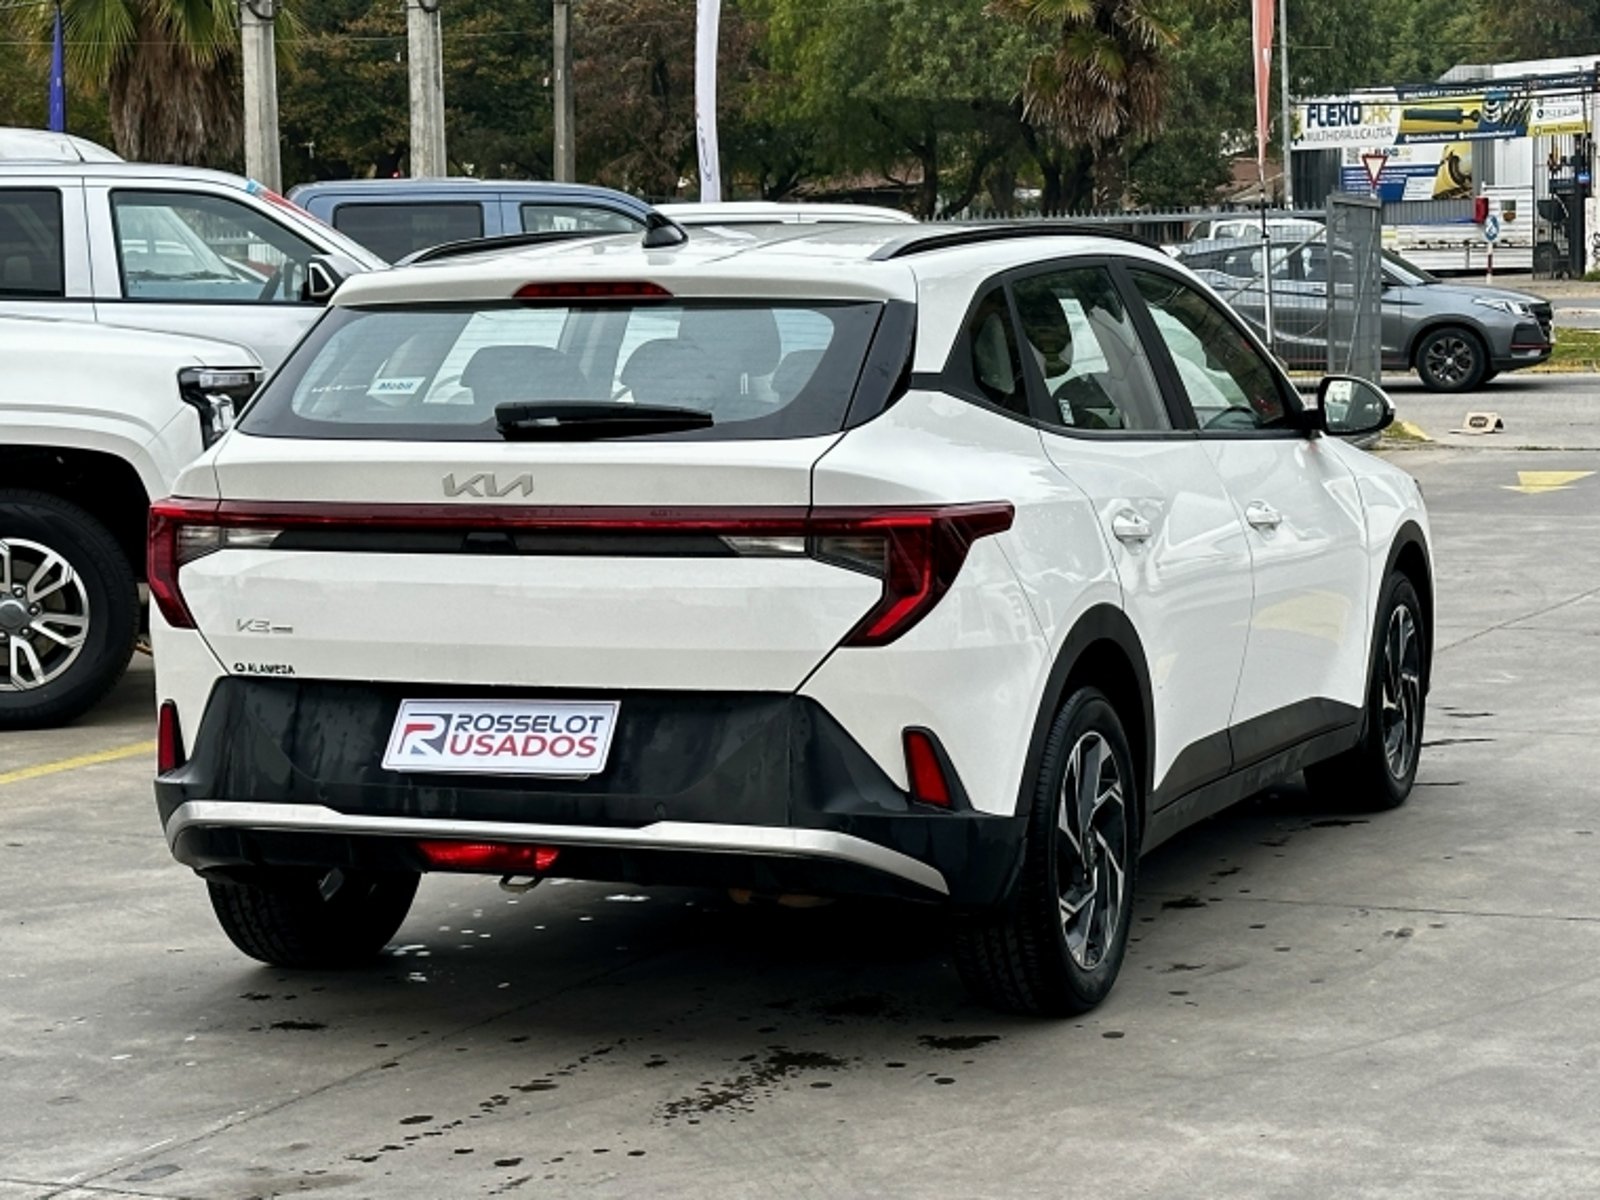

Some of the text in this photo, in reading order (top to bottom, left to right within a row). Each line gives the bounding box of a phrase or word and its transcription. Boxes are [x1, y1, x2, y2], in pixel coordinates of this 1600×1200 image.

[442, 472, 533, 497] KIA
[454, 713, 605, 734] ROSSELOT
[449, 734, 598, 758] USADOS
